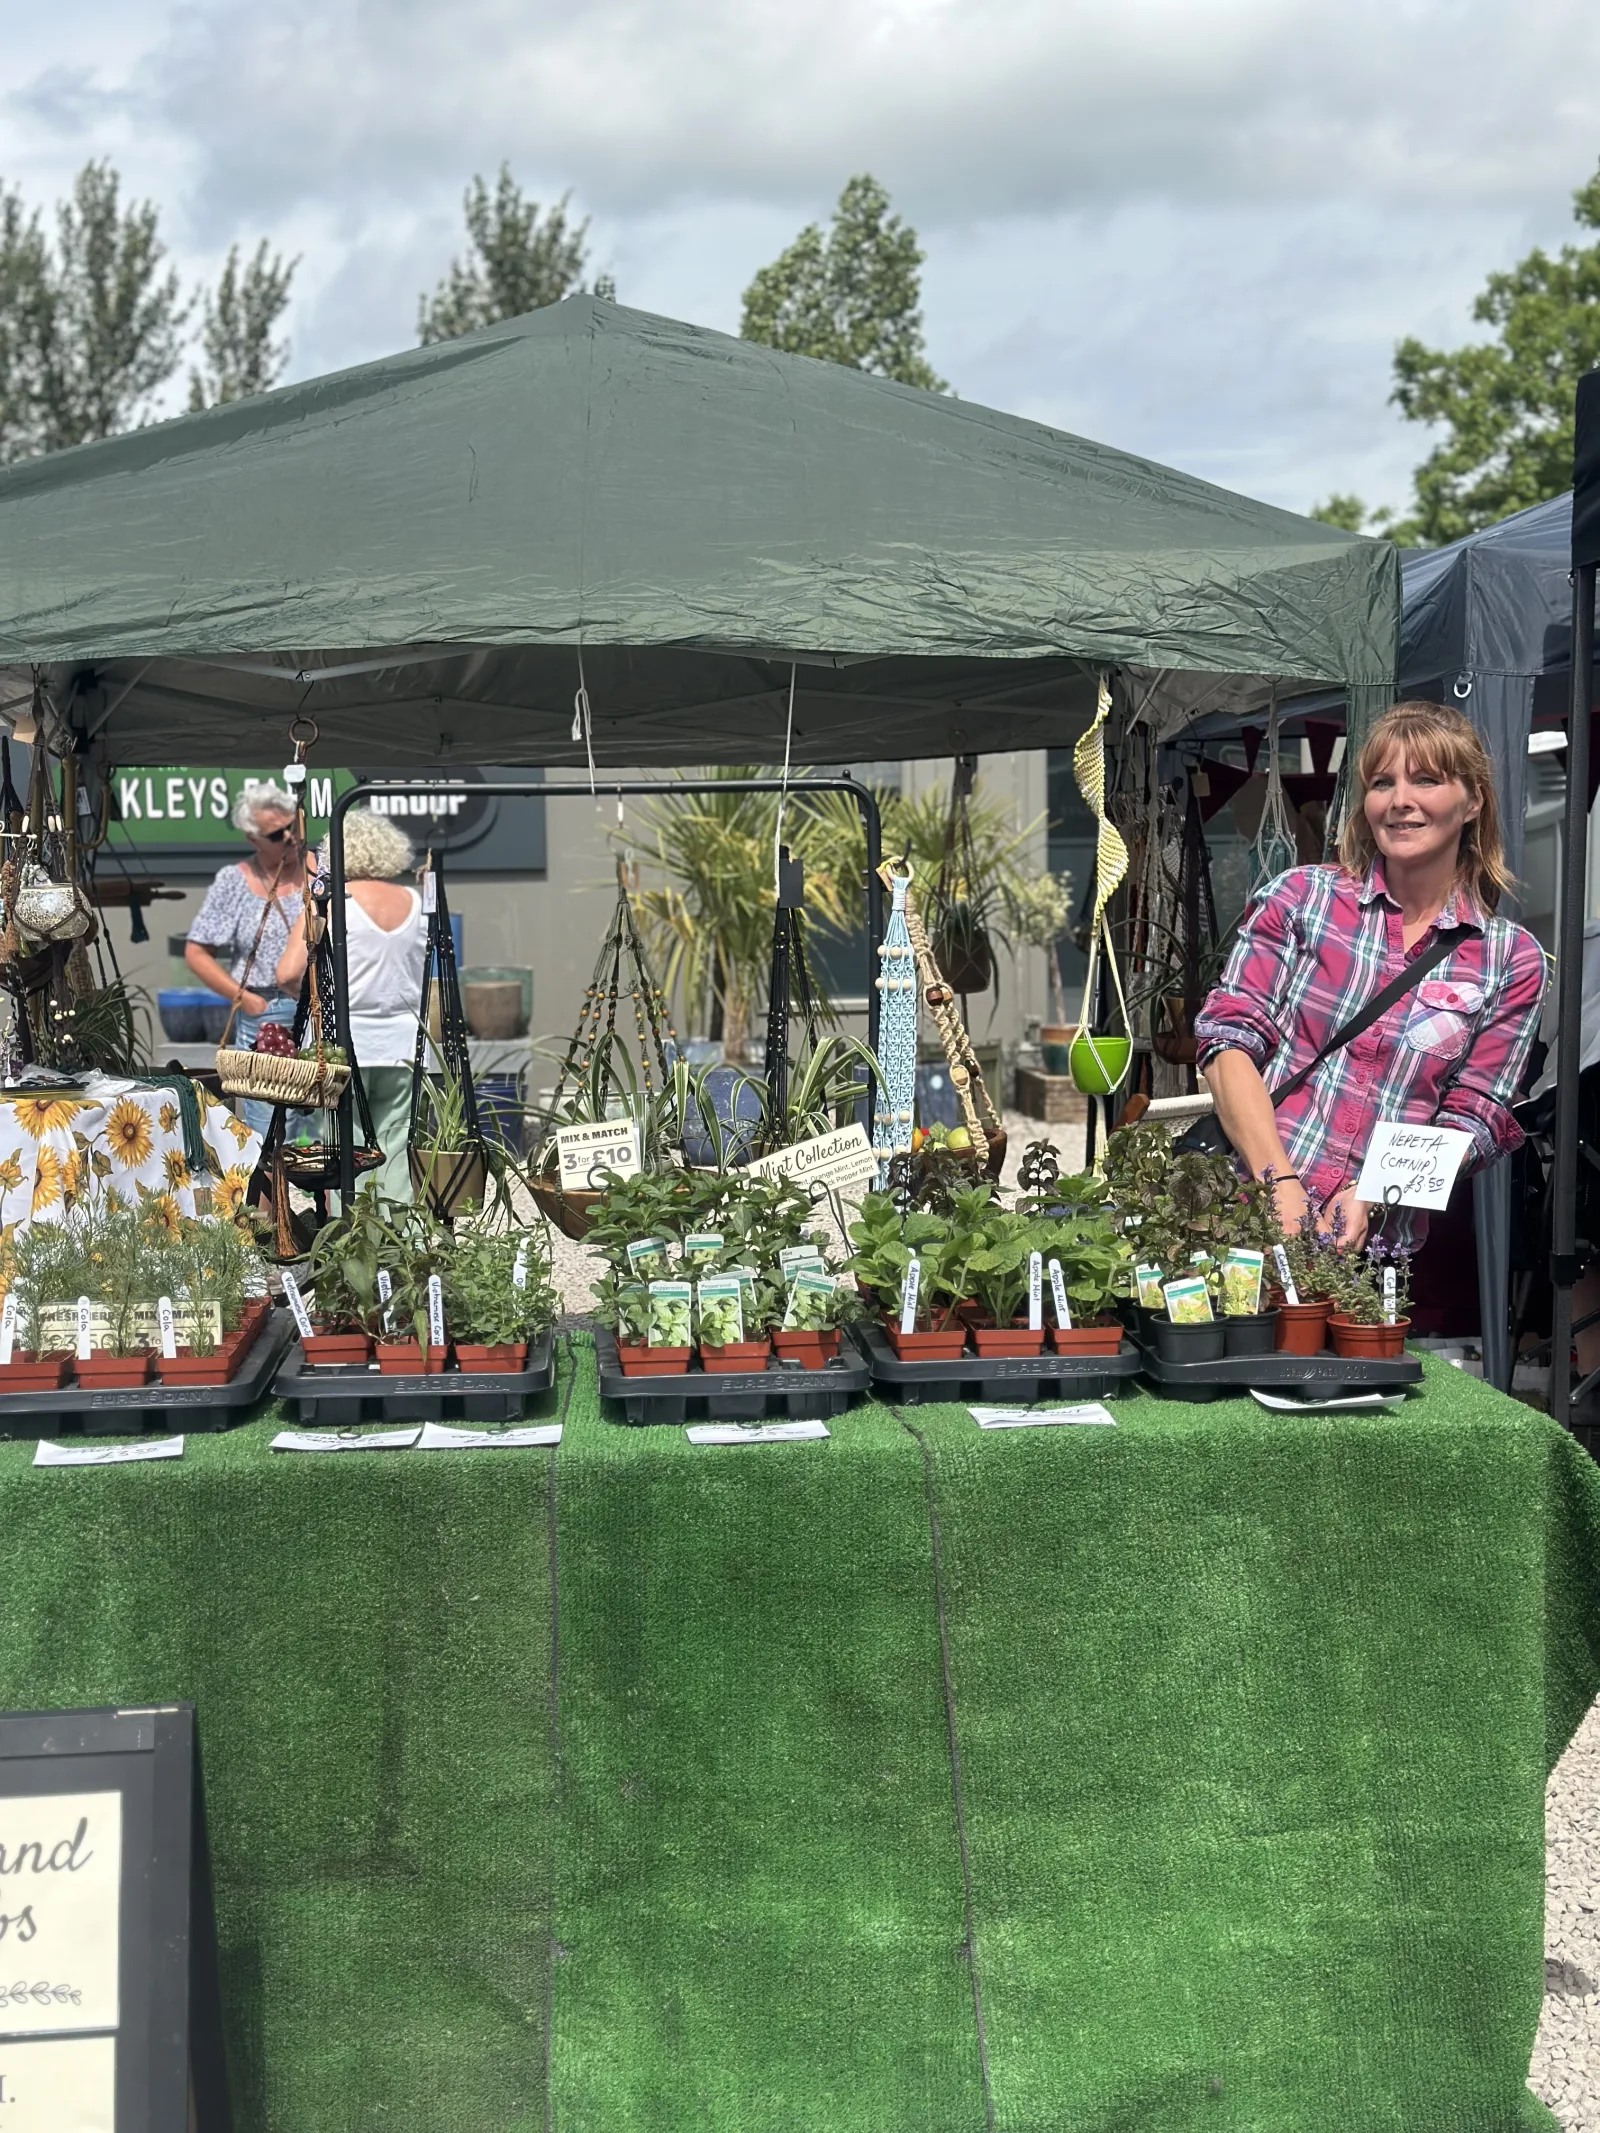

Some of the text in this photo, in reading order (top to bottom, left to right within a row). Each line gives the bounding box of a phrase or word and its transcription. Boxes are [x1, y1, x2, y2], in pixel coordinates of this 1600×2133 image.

[561, 1126, 629, 1145] MIX & MATCH
[1388, 1129, 1449, 1153] NEPETA
[563, 1146, 632, 1170] 3 for £10
[759, 1136, 863, 1181] Mint Collection
[810, 1171, 834, 1182] Orange
[850, 1156, 873, 1169] Lemon
[1380, 1152, 1438, 1176] (CATNIP)
[836, 1171, 858, 1183] Pepper
[859, 1164, 875, 1175] Mint
[1403, 1174, 1445, 1194] £3.50
[908, 1266, 919, 1290] Apple
[1032, 1260, 1041, 1282] Apple
[1051, 1268, 1062, 1293] Apple
[4, 1305, 16, 1329] Cola
[80, 1308, 89, 1332] Cola
[162, 1309, 173, 1332] Cola
